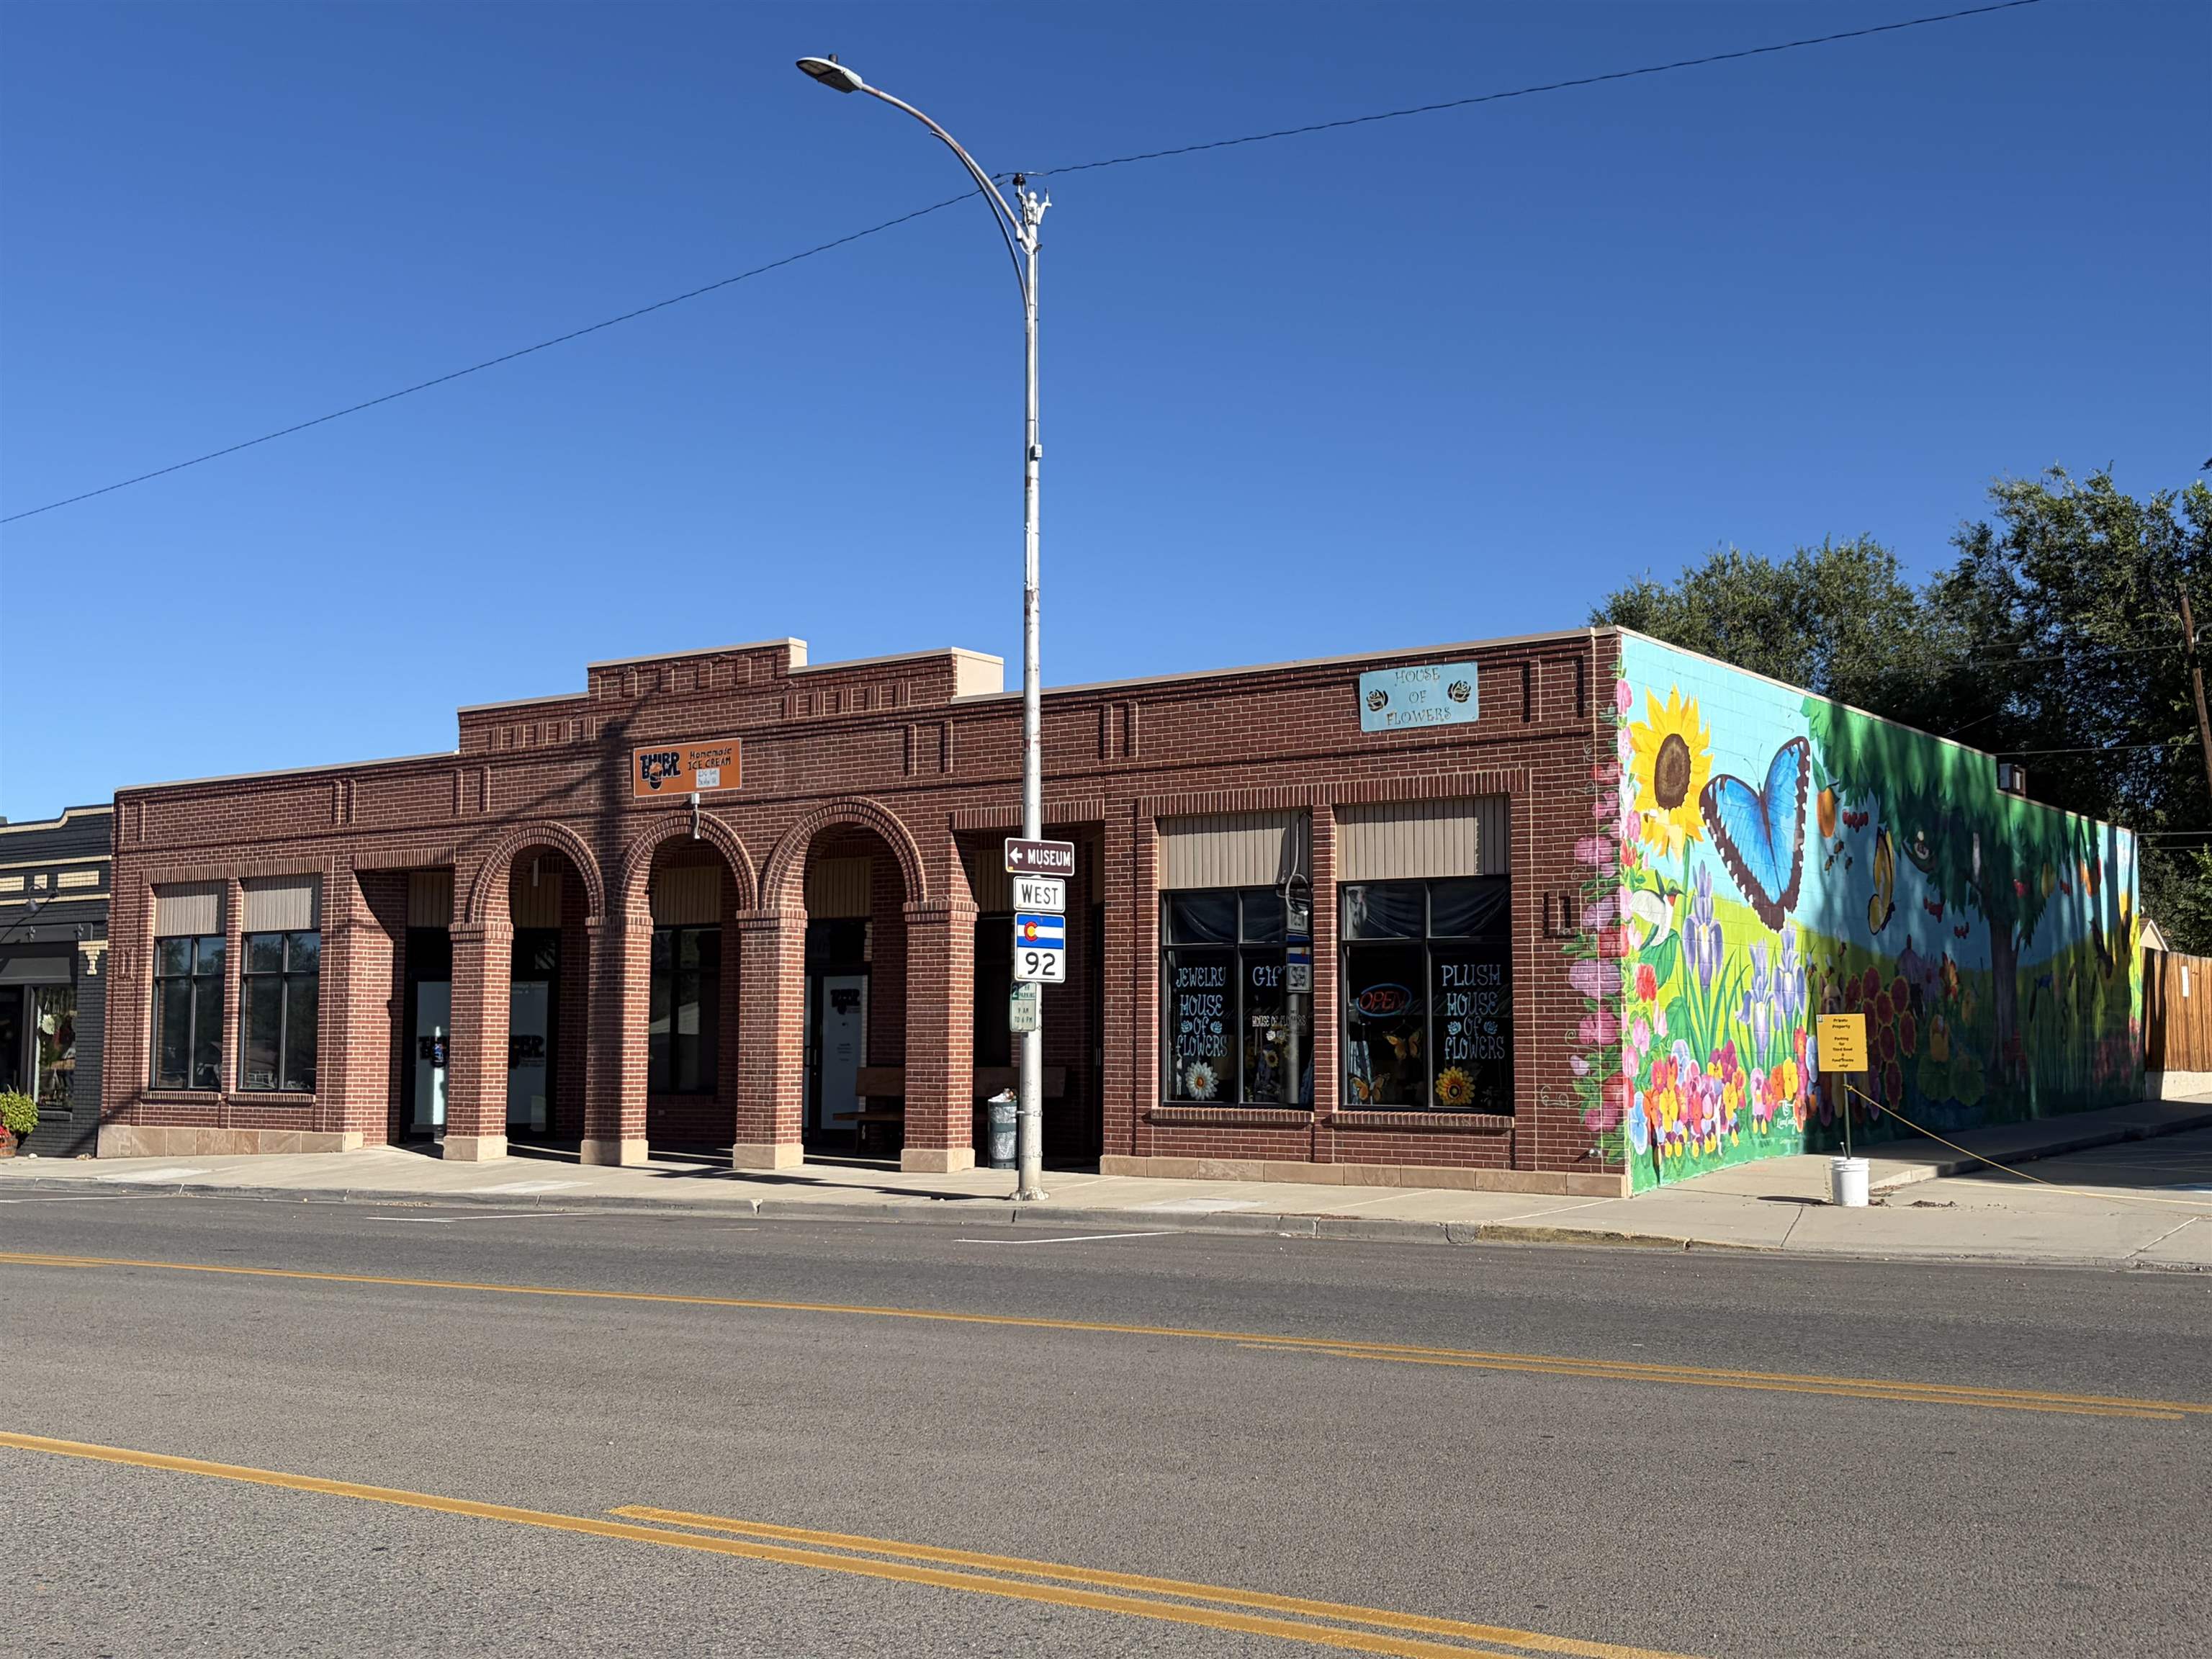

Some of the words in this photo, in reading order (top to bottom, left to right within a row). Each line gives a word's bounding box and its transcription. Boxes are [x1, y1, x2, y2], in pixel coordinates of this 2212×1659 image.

[1395, 667, 1440, 686] HOUSE
[1408, 690, 1427, 703] OF
[1387, 707, 1452, 726] FLOWERS
[640, 752, 680, 766] THIRD
[690, 747, 732, 759] Homemade
[642, 763, 681, 780] BOWL
[688, 761, 703, 770] ICE
[705, 757, 731, 768] CREAM
[1028, 848, 1071, 867] MUSEUM
[1022, 884, 1058, 905] WEST
[1025, 952, 1056, 976] 92
[1176, 967, 1226, 987] JEWELRY
[1442, 964, 1501, 986] PLUSH
[1012, 985, 1018, 997] 2
[1179, 994, 1223, 1016] HOUSE
[1359, 991, 1406, 1011] OPEN
[1447, 992, 1498, 1016] HOUSE
[1192, 1017, 1209, 1035] OF
[1464, 1015, 1482, 1036] OF
[1177, 1035, 1228, 1057] FLOWERS
[1445, 1036, 1505, 1060] FLOWERS
